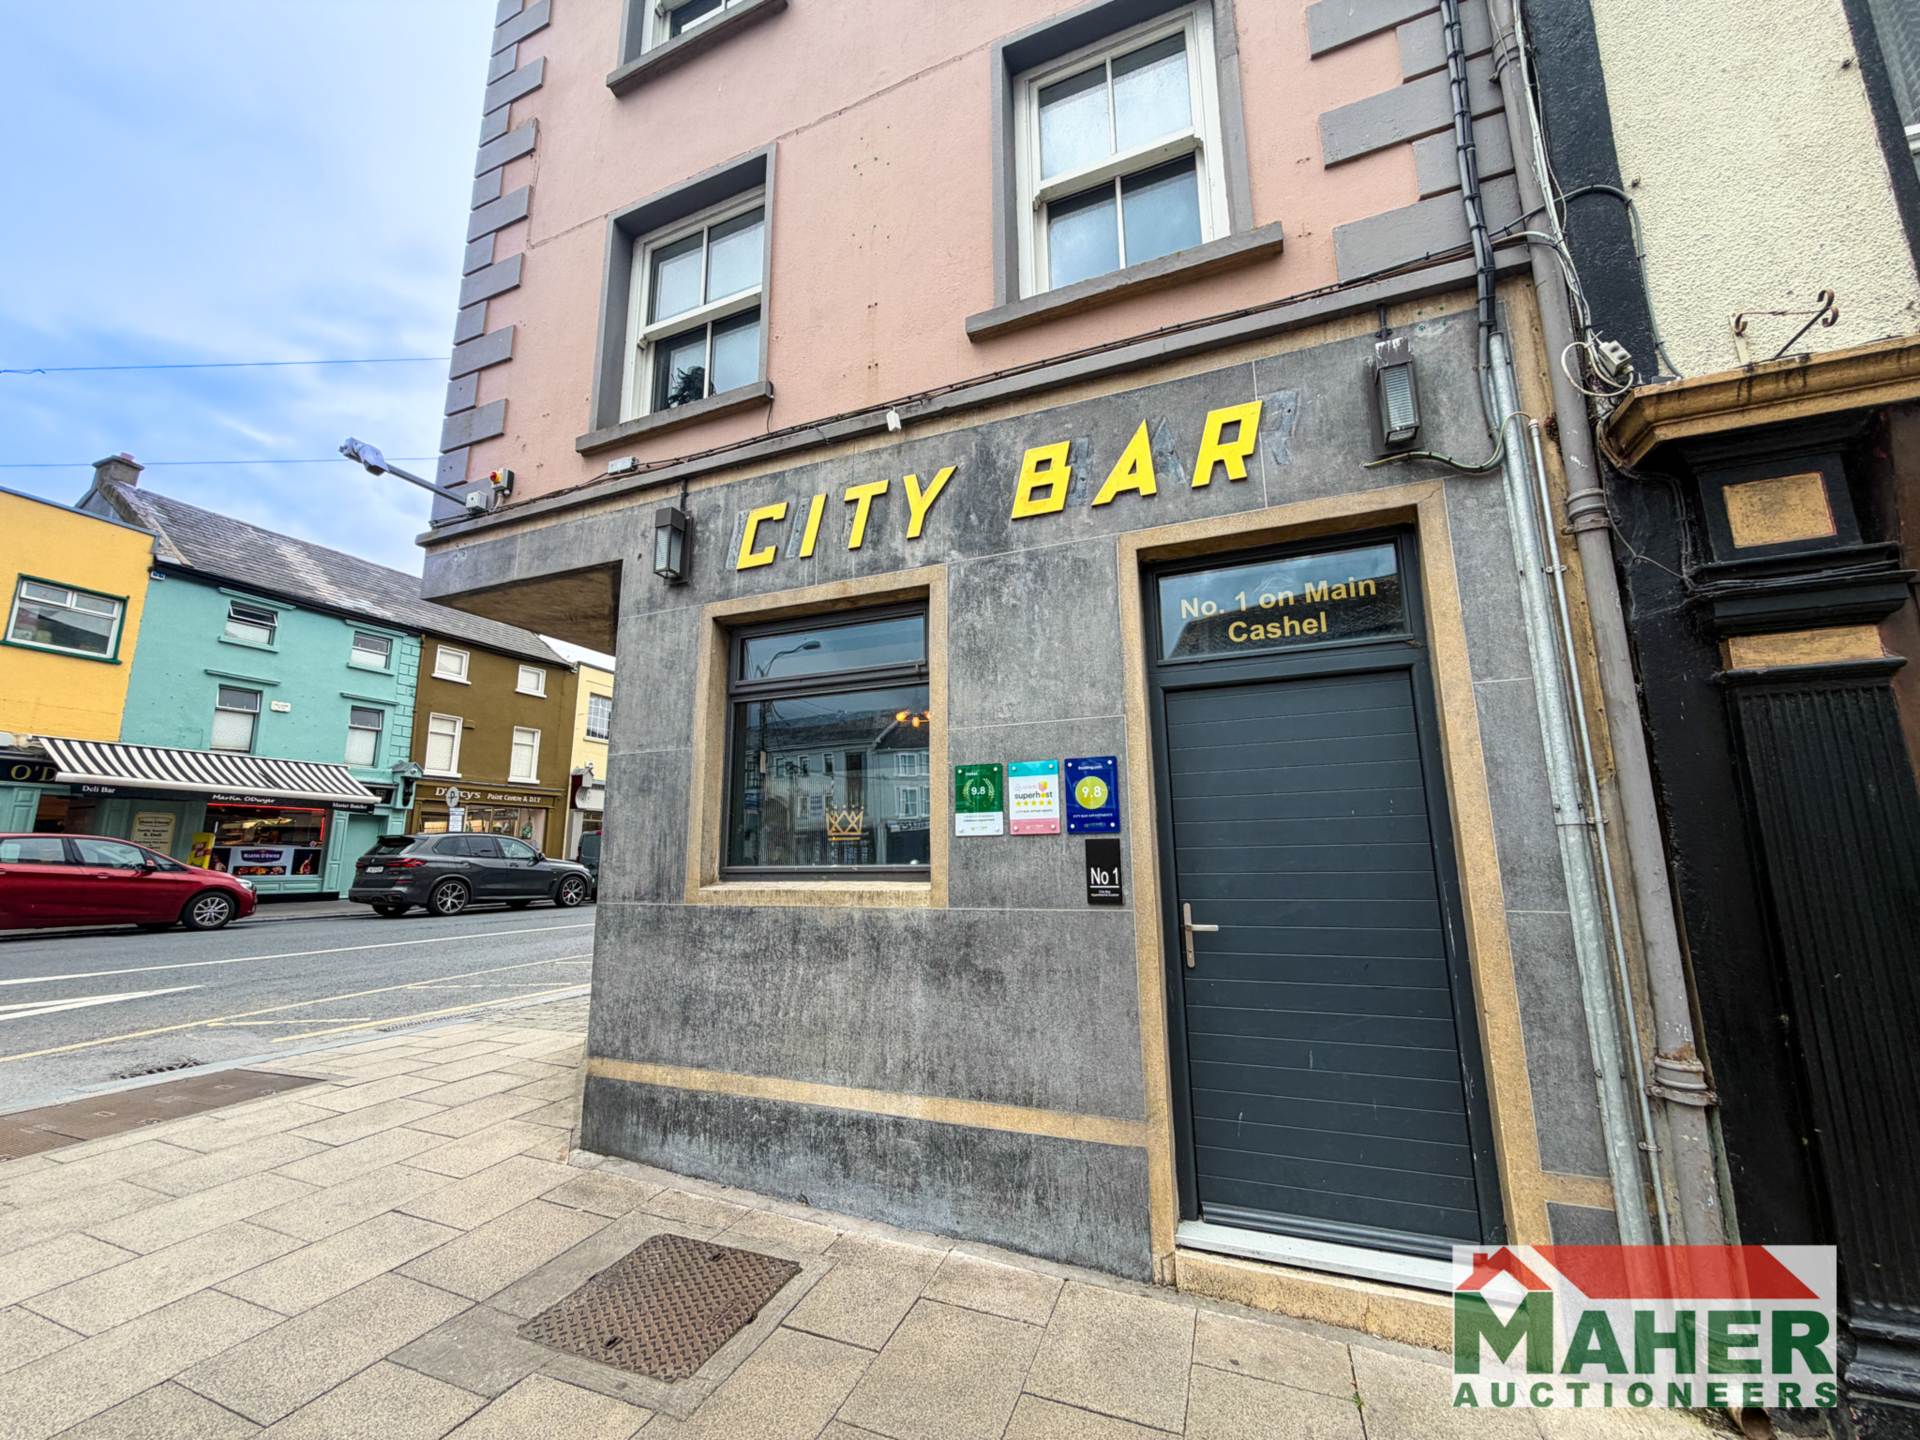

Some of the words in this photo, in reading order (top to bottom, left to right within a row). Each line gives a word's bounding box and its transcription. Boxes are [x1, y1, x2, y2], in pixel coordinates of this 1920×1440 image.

[736, 466, 957, 569] CITY
[1011, 400, 1262, 519] BAR
[1180, 597, 1224, 619] No.
[1235, 591, 1247, 612] 1
[1259, 589, 1295, 609] on
[1304, 577, 1377, 603] Main
[1228, 611, 1327, 643] Cashel
[487, 793, 503, 801] Paint
[971, 786, 986, 796] 9.8
[1014, 791, 1053, 800] superhost
[1081, 786, 1102, 798] 9.8
[1090, 867, 1109, 885] No
[1112, 867, 1119, 885] 1
